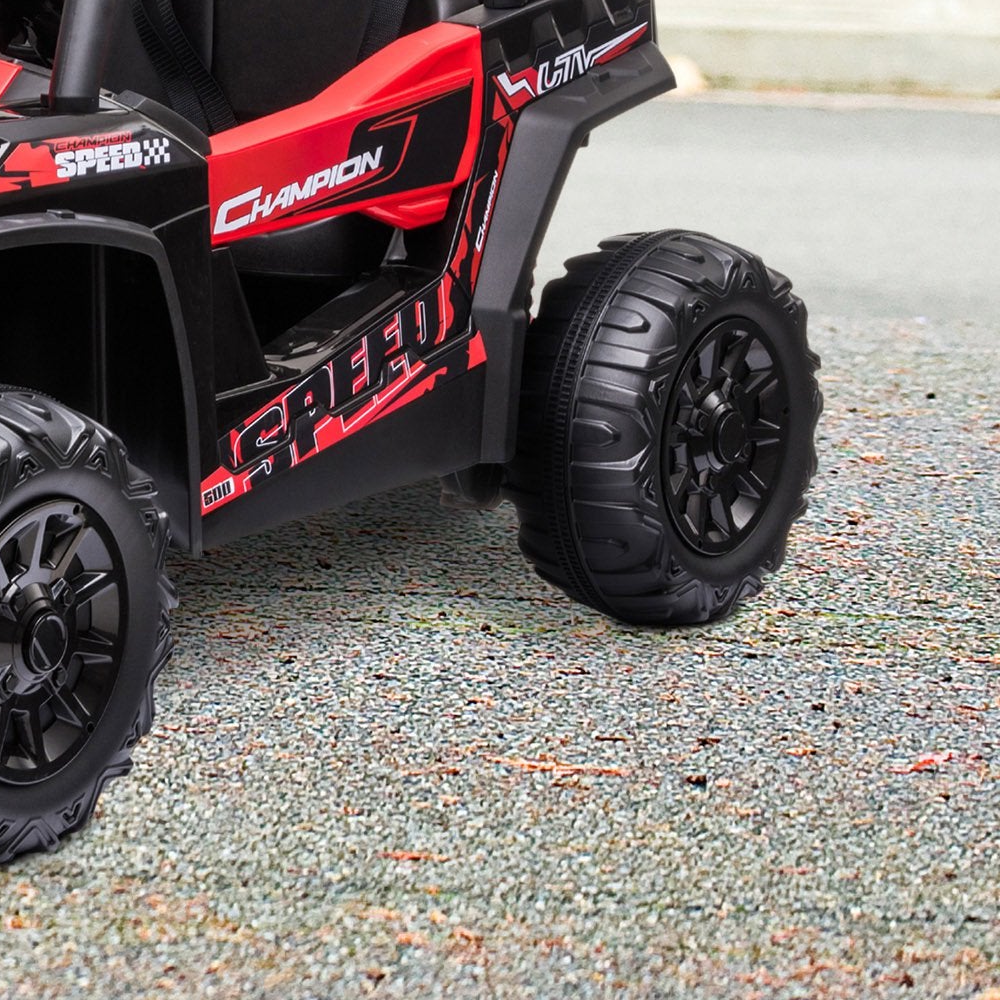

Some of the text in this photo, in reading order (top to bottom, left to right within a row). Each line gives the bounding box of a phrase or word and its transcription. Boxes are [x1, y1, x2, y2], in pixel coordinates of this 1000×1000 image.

[55, 131, 132, 151] CHAMPION
[55, 141, 143, 178] SPEED
[213, 145, 384, 235] CHAMPION
[475, 169, 499, 252] CHAMPION
